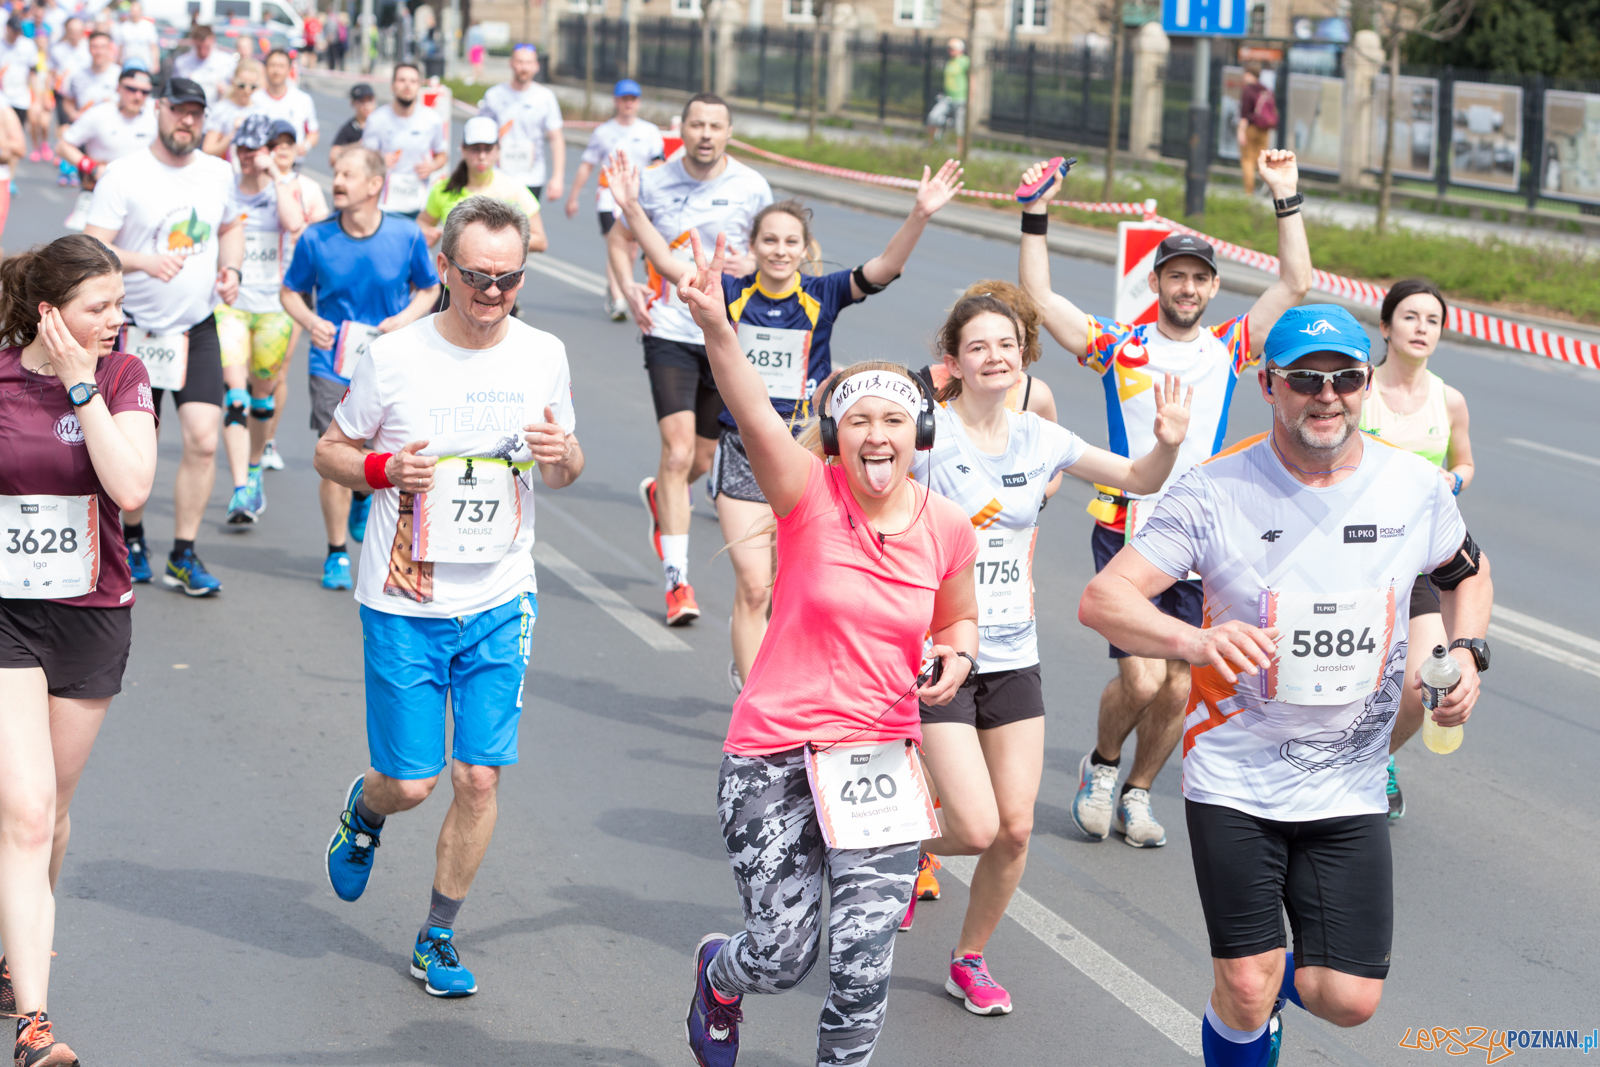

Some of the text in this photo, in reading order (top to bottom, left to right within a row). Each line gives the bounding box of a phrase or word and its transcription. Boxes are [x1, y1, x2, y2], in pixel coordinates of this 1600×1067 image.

[136, 346, 175, 362] 5999
[746, 349, 792, 368] 6831
[466, 388, 524, 404] KOŚCIAN
[429, 405, 524, 435] TEAM
[451, 499, 500, 522] 737
[457, 527, 493, 535] TADEUSZ
[1260, 530, 1283, 542] 4F
[6, 527, 78, 555] 3628
[33, 561, 48, 570] Iga
[975, 559, 1020, 584] 1756
[989, 590, 1012, 598] Joanna
[1291, 627, 1376, 658] 5884
[1313, 663, 1356, 672] Jarosław
[840, 773, 897, 806] 420
[851, 804, 899, 819] Aleksandra
